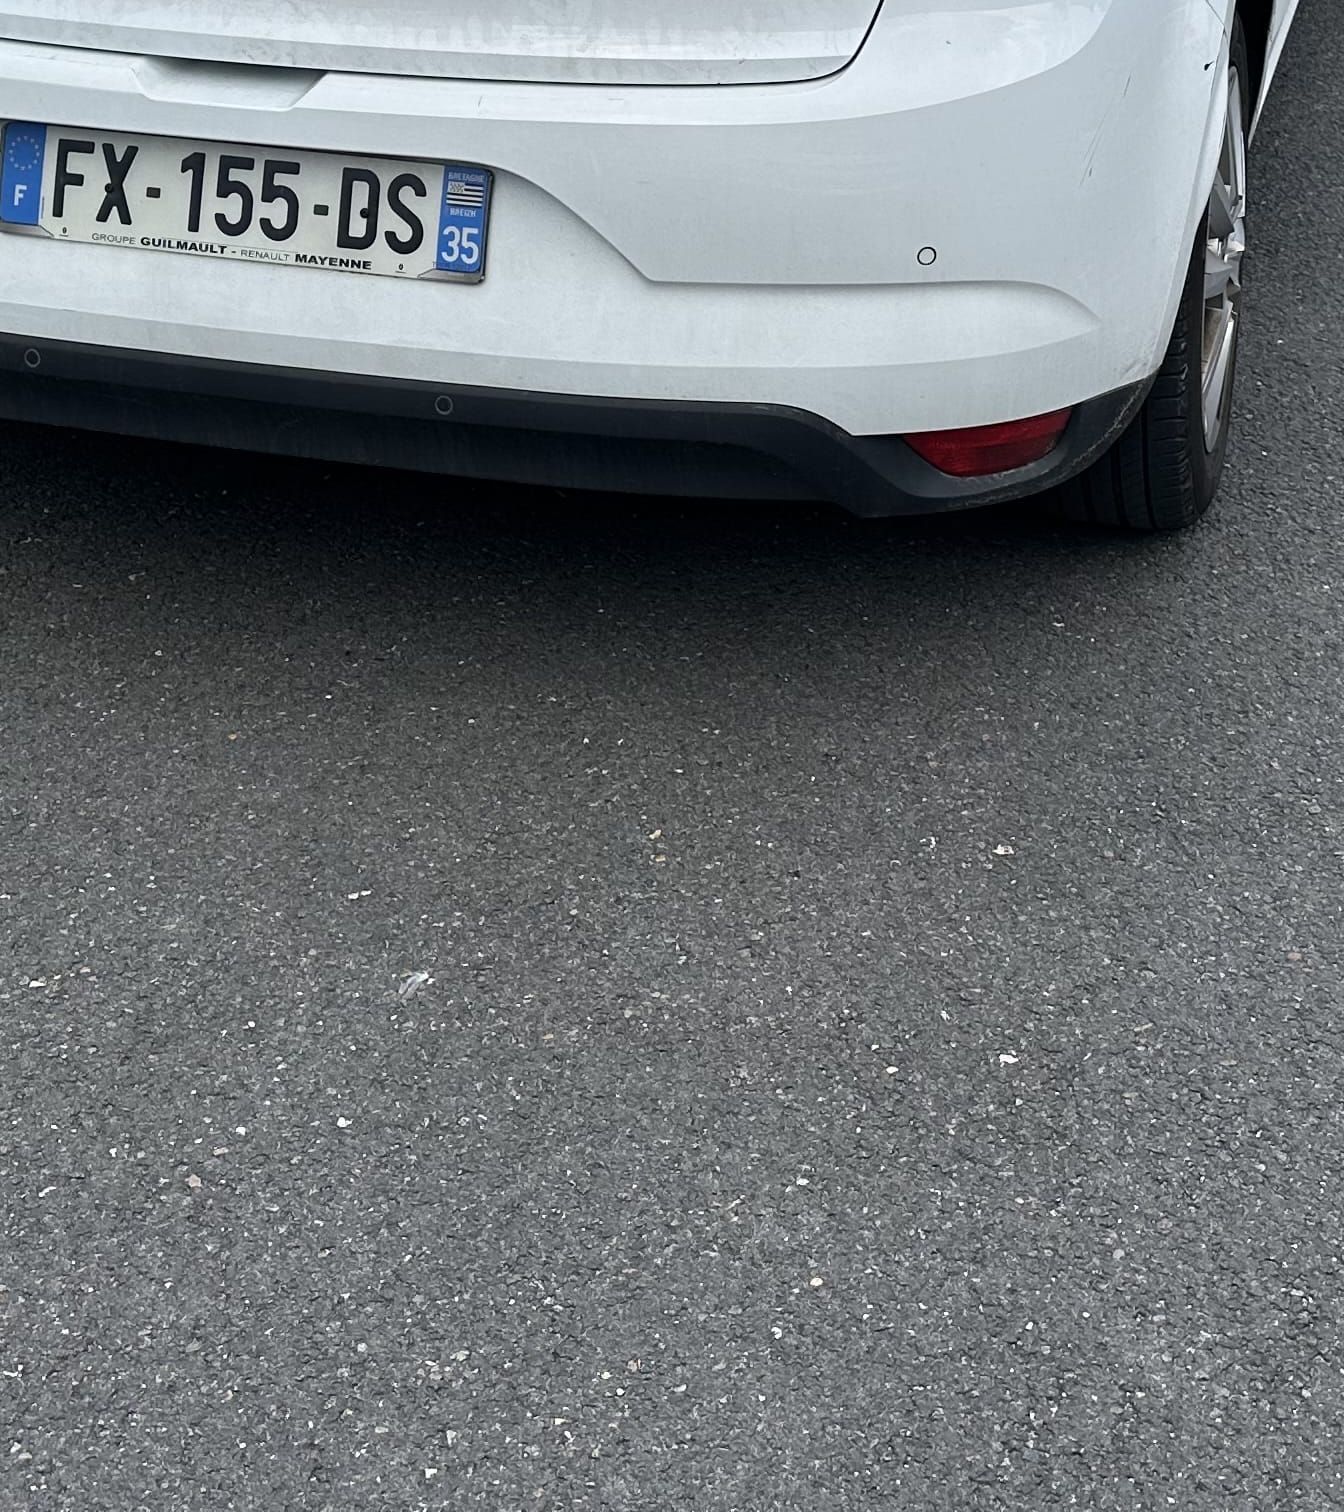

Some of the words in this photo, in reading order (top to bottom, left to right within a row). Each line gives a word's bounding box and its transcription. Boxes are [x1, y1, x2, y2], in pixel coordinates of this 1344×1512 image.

[14, 184, 27, 206] F
[52, 138, 427, 255] FX-155-DS
[91, 232, 136, 245] GROUPE
[140, 236, 227, 255] GUILMAULT
[240, 249, 290, 261] RENAULT
[294, 253, 373, 270] MAYENNE
[441, 225, 479, 264] 35
